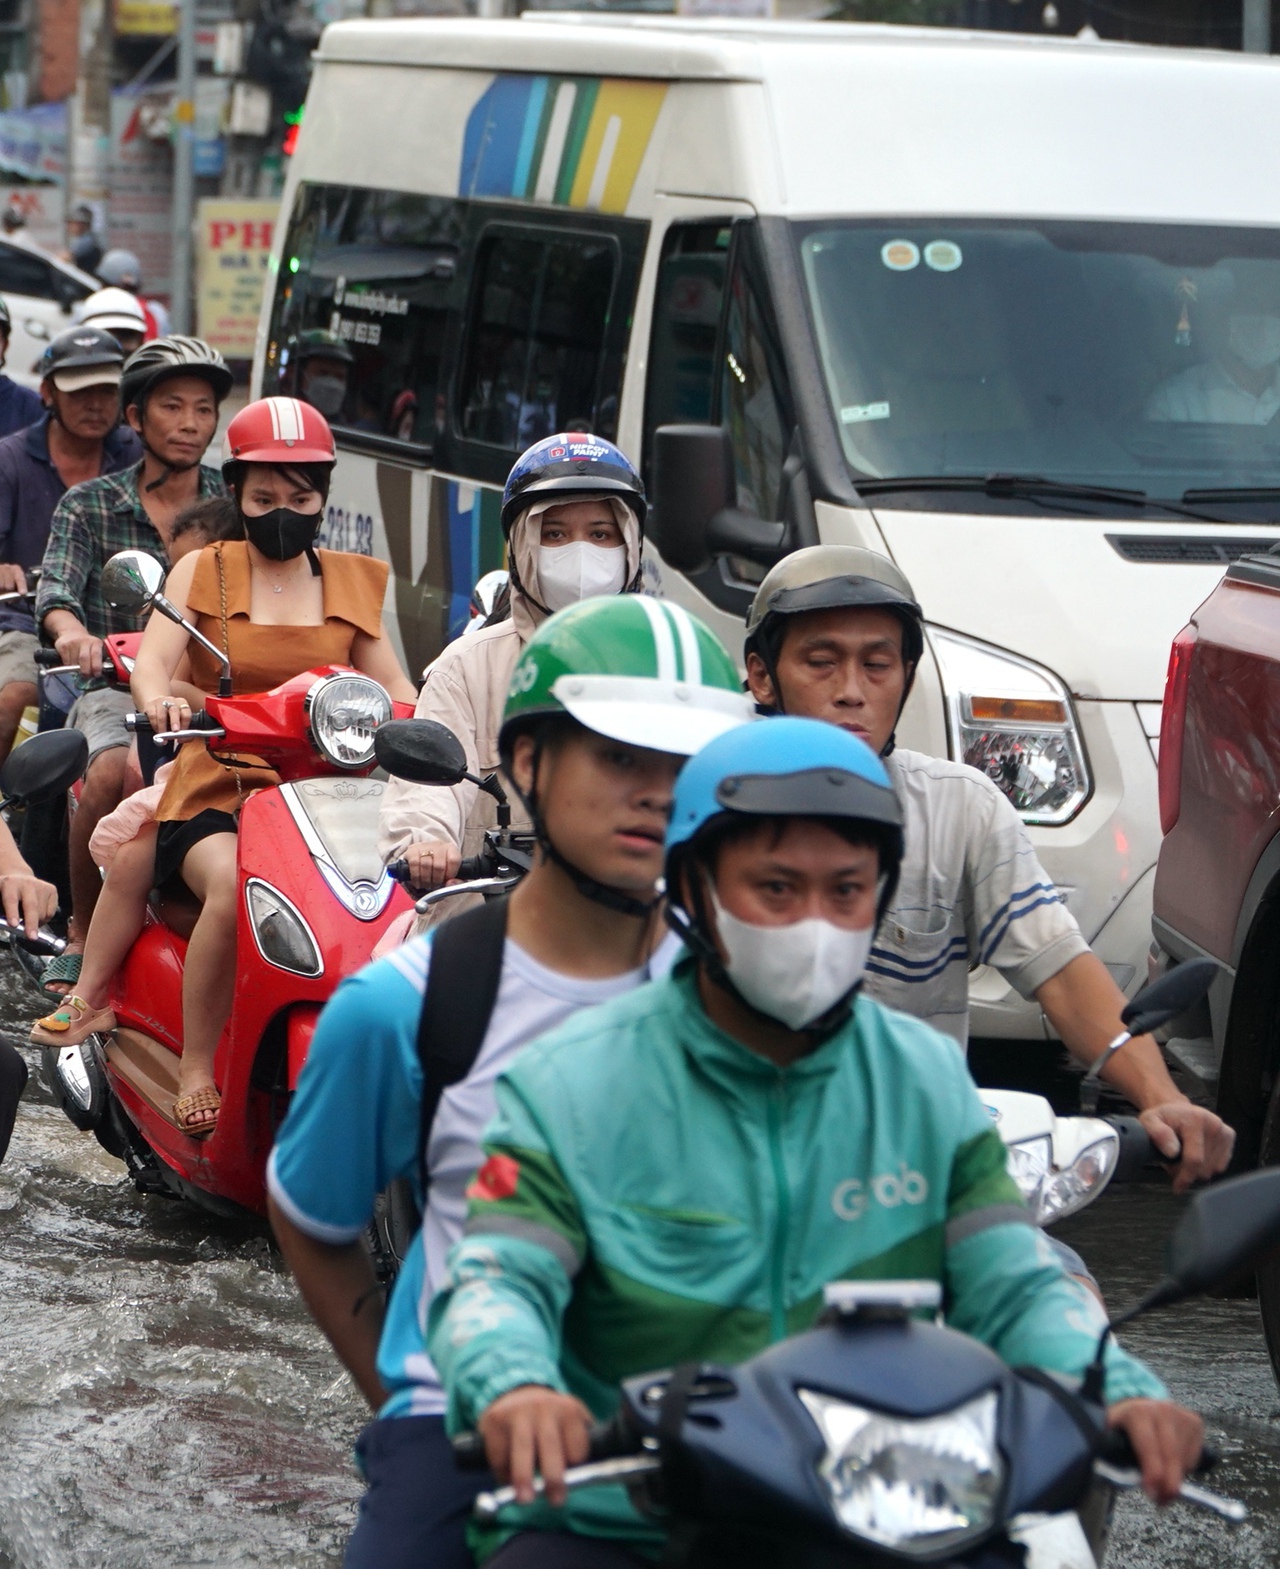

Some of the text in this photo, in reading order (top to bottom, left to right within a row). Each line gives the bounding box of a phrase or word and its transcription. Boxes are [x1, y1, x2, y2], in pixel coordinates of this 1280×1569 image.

[569, 443, 609, 455] NIPPON
[573, 449, 603, 458] PAINT
[831, 1160, 928, 1221] Gab
